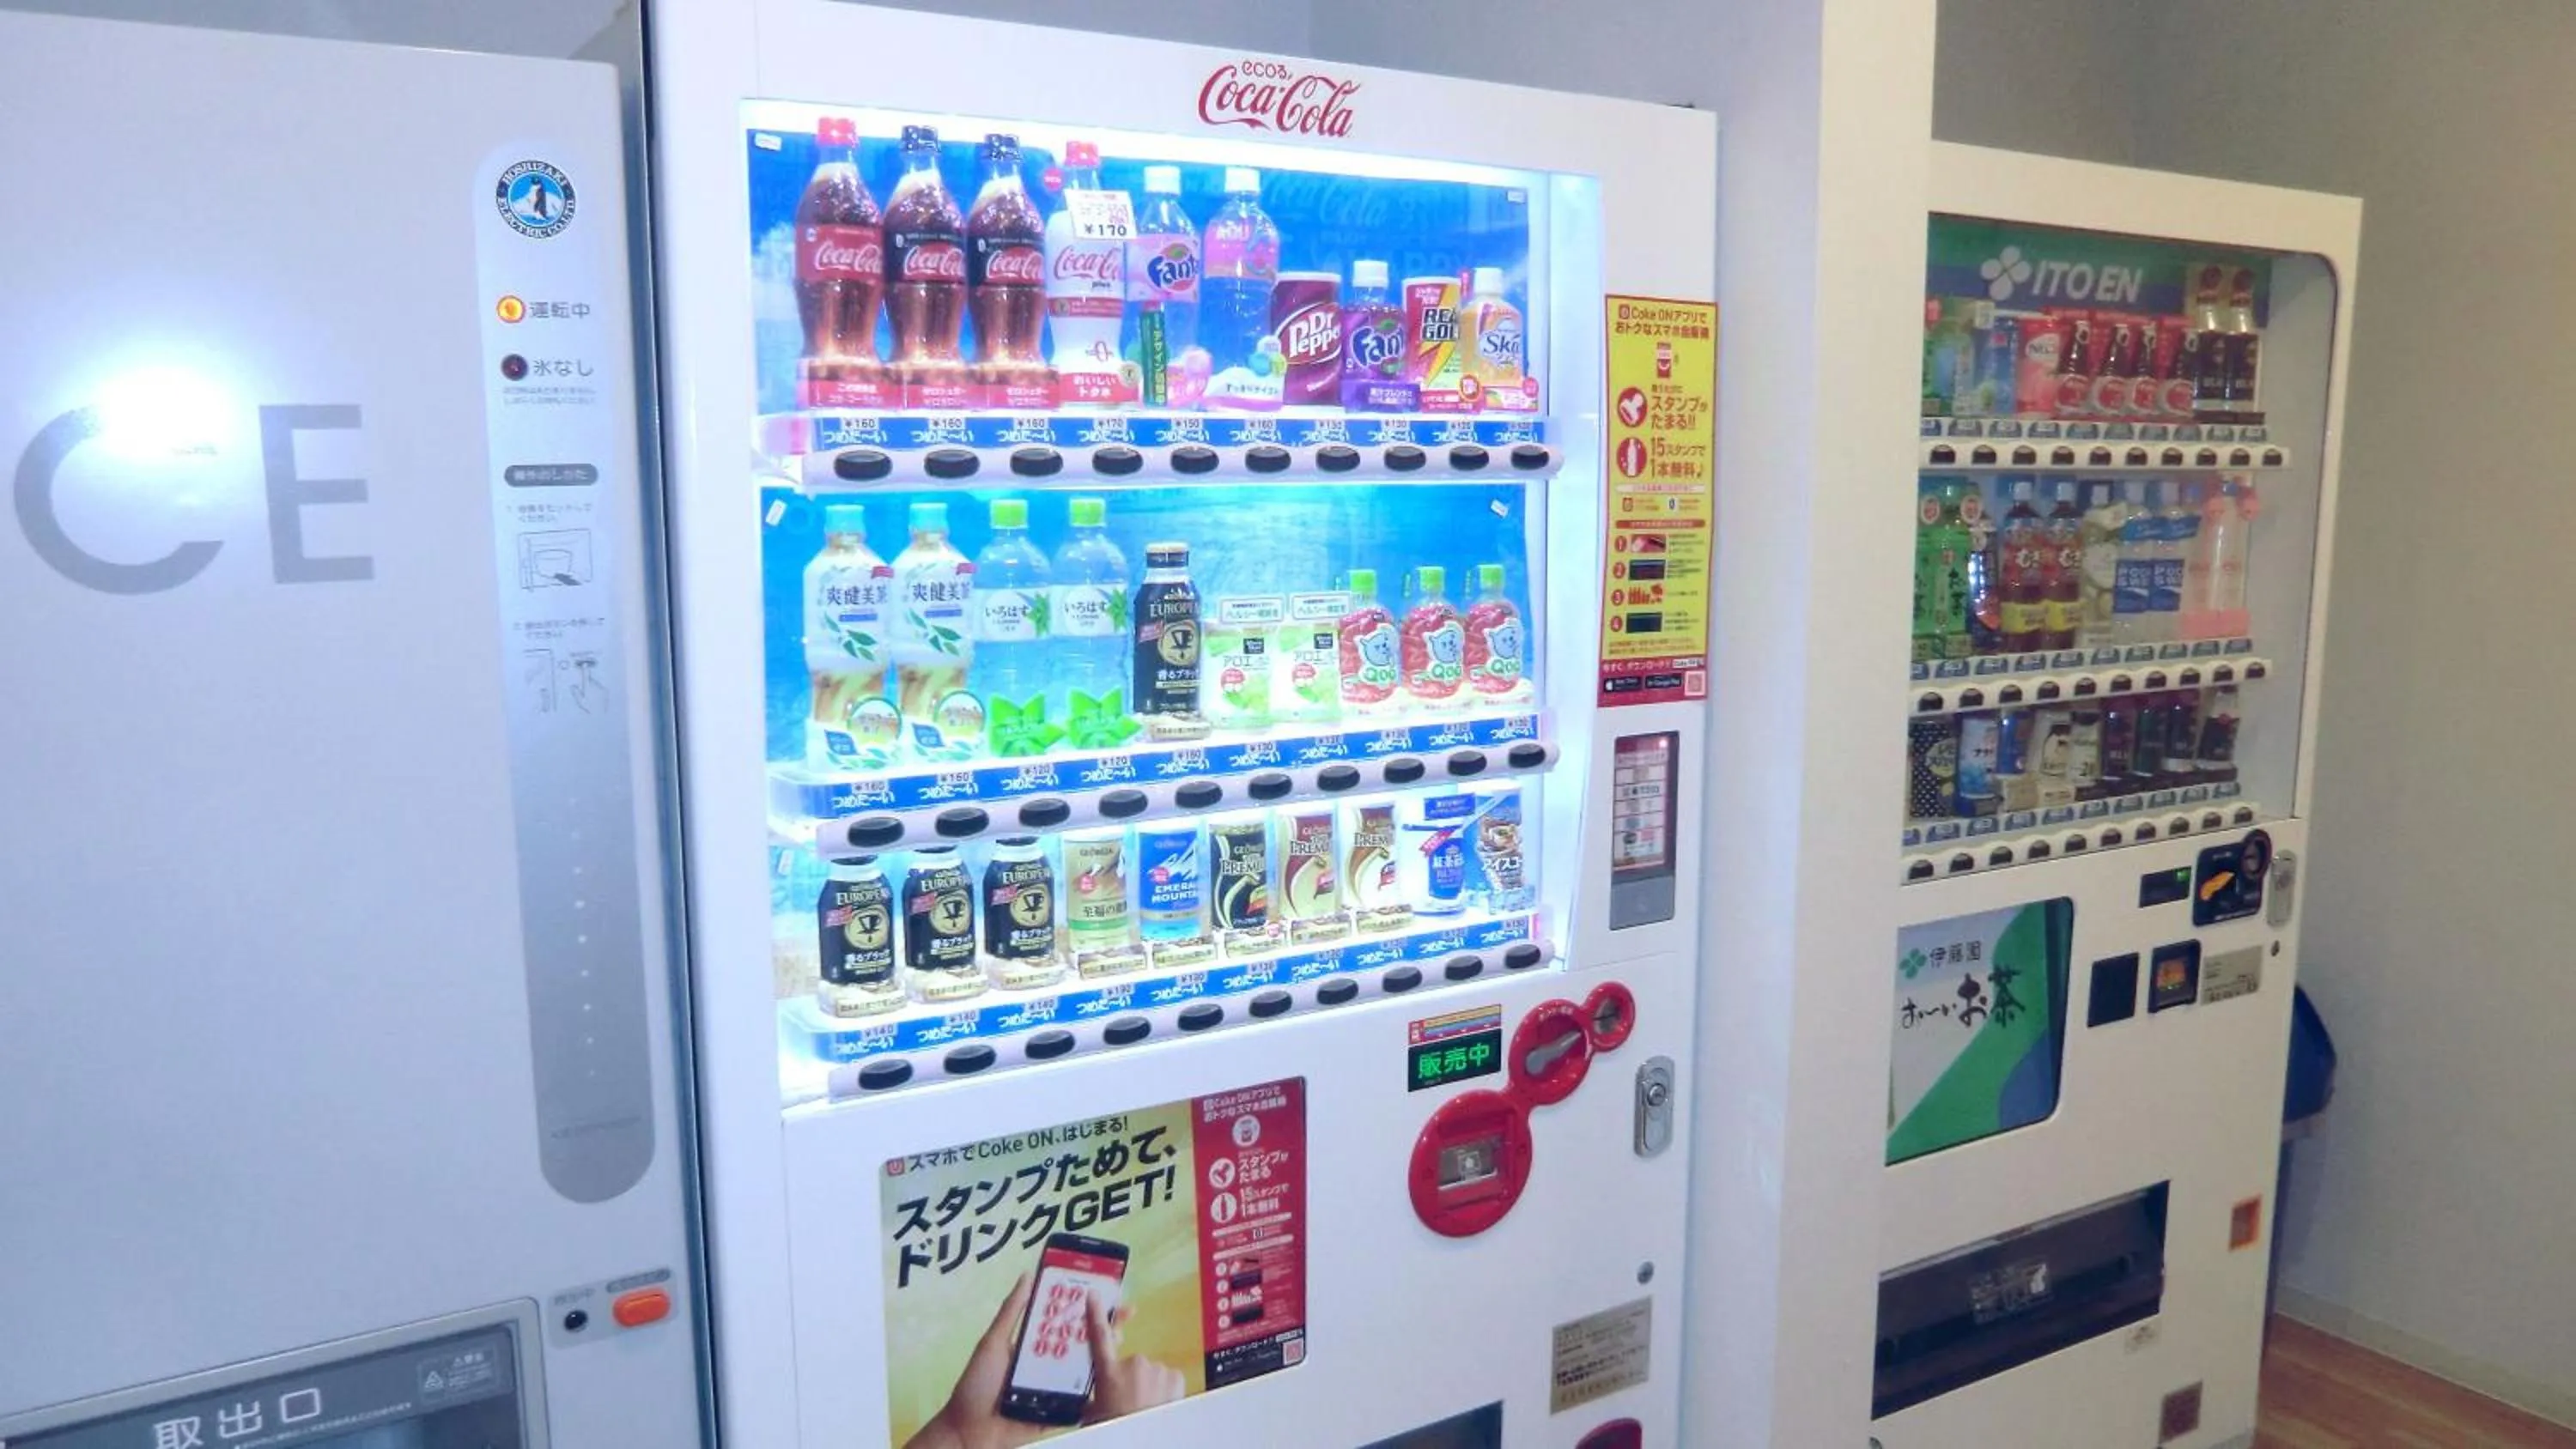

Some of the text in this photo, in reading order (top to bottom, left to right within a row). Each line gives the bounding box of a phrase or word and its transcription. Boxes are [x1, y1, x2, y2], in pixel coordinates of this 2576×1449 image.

[1198, 64, 1361, 137] Coca-Cola
[1084, 224, 1127, 236] ¥170
[904, 246, 965, 276] Coca-Co
[986, 249, 1046, 279] Coca-Co
[1054, 245, 1121, 281] Coca-Co
[1147, 254, 1197, 288] Fant
[2032, 259, 2143, 303] ITO EN
[529, 301, 590, 318] 運転中
[1423, 308, 1457, 324] REA
[1631, 306, 1656, 320] Coke
[1309, 312, 1334, 335] Dr
[1422, 323, 1458, 341] GOL
[1289, 318, 1341, 357] Peppe
[1352, 327, 1403, 367] Fan
[533, 358, 594, 376] 氷なし
[826, 585, 888, 606] 爽健美茶
[913, 581, 971, 602] 爽健美茶
[1364, 666, 1396, 683] Qoo
[1431, 664, 1461, 682] Qoo
[1492, 658, 1521, 676] Qoo
[1151, 890, 1198, 903] MOUNTA
[1155, 882, 1198, 894] EMERA
[1929, 940, 1982, 968] 伊藤園
[1419, 1043, 1490, 1078] 販売中
[893, 1126, 1177, 1240] スタンプためて、
[898, 1165, 1176, 1288] ドリンクGET!
[153, 1387, 320, 1449] 取出口
